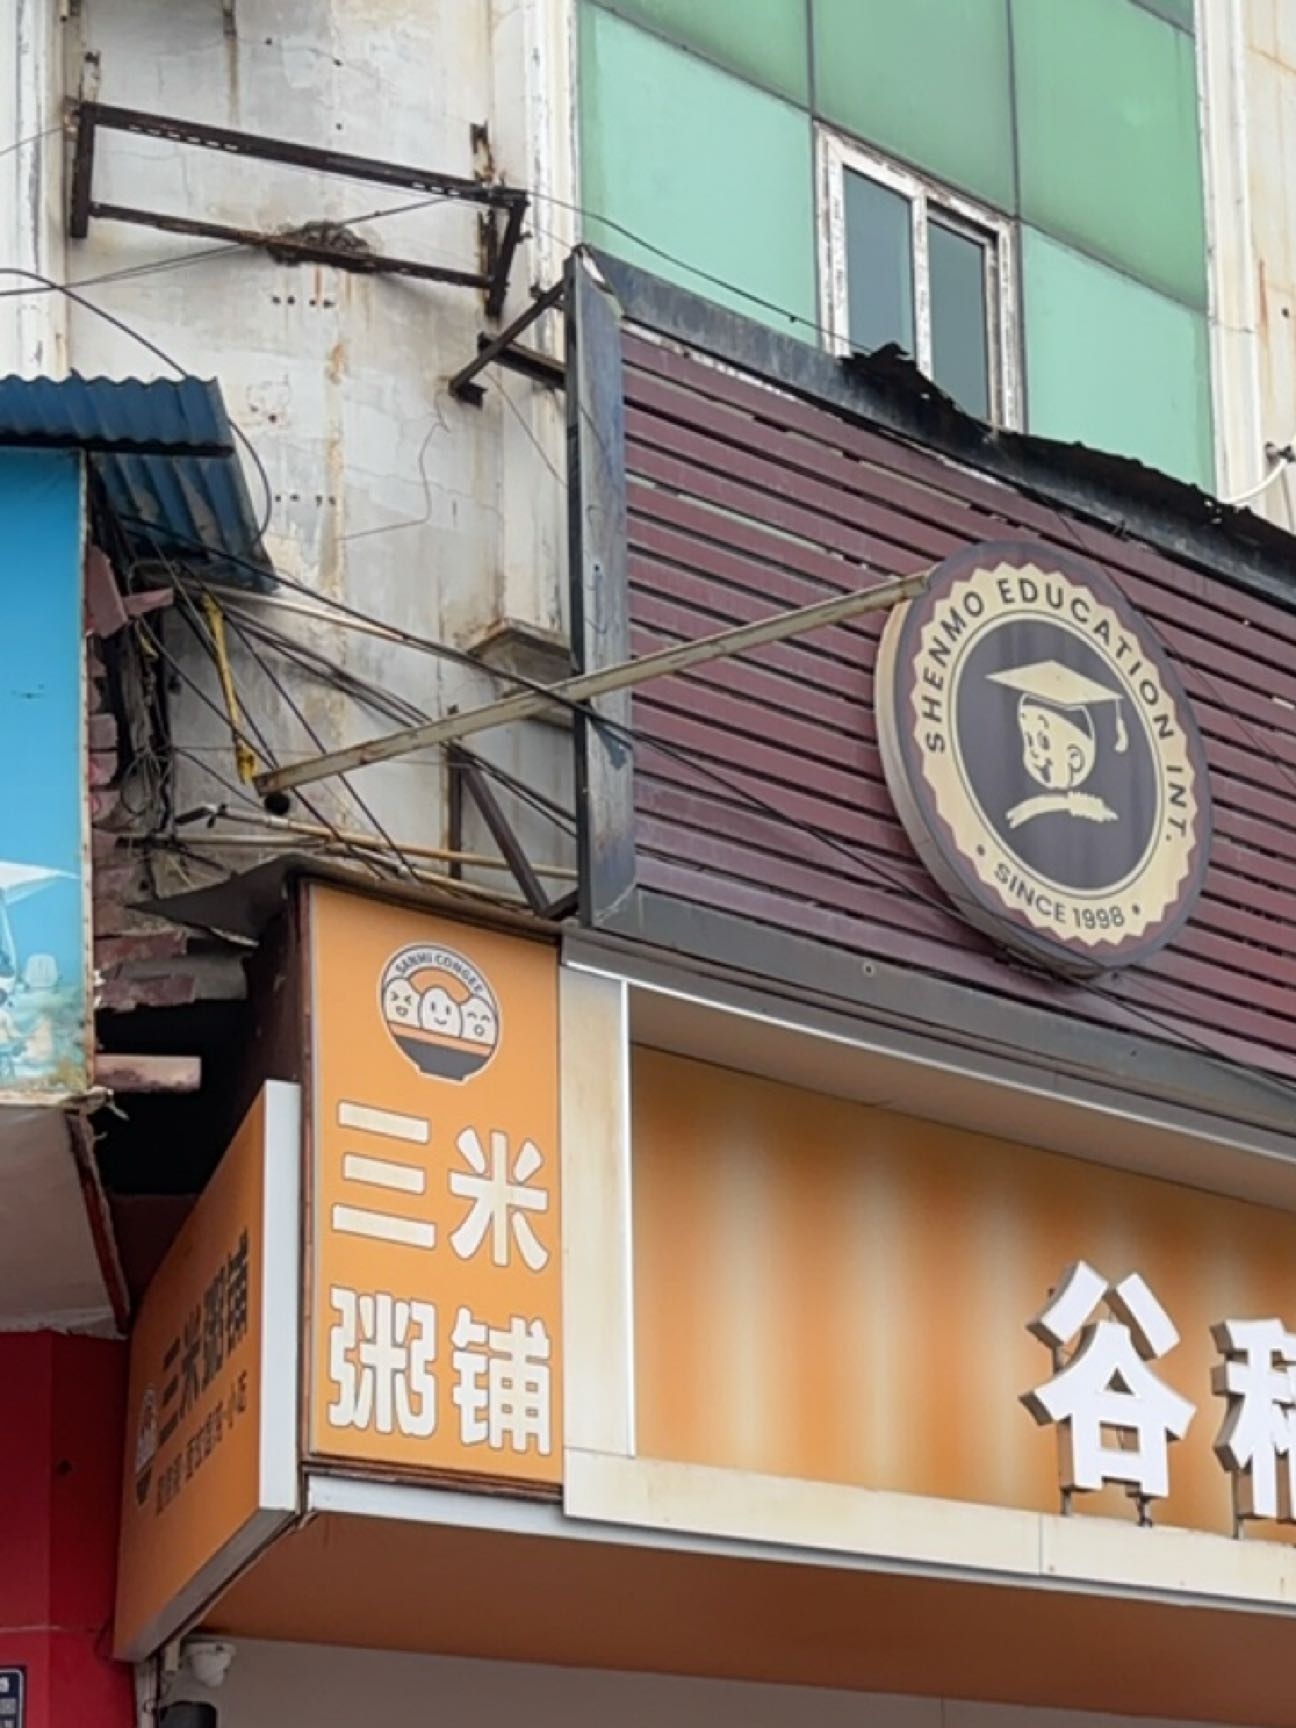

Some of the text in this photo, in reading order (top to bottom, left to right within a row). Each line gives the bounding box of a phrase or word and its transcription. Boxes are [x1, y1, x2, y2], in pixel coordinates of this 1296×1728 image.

[922, 576, 1187, 843] SHENMO EDUCATION INT.
[993, 862, 1126, 930] SINCE 1998
[331, 1100, 550, 1272] 三米
[329, 1287, 551, 1456] 粥铺
